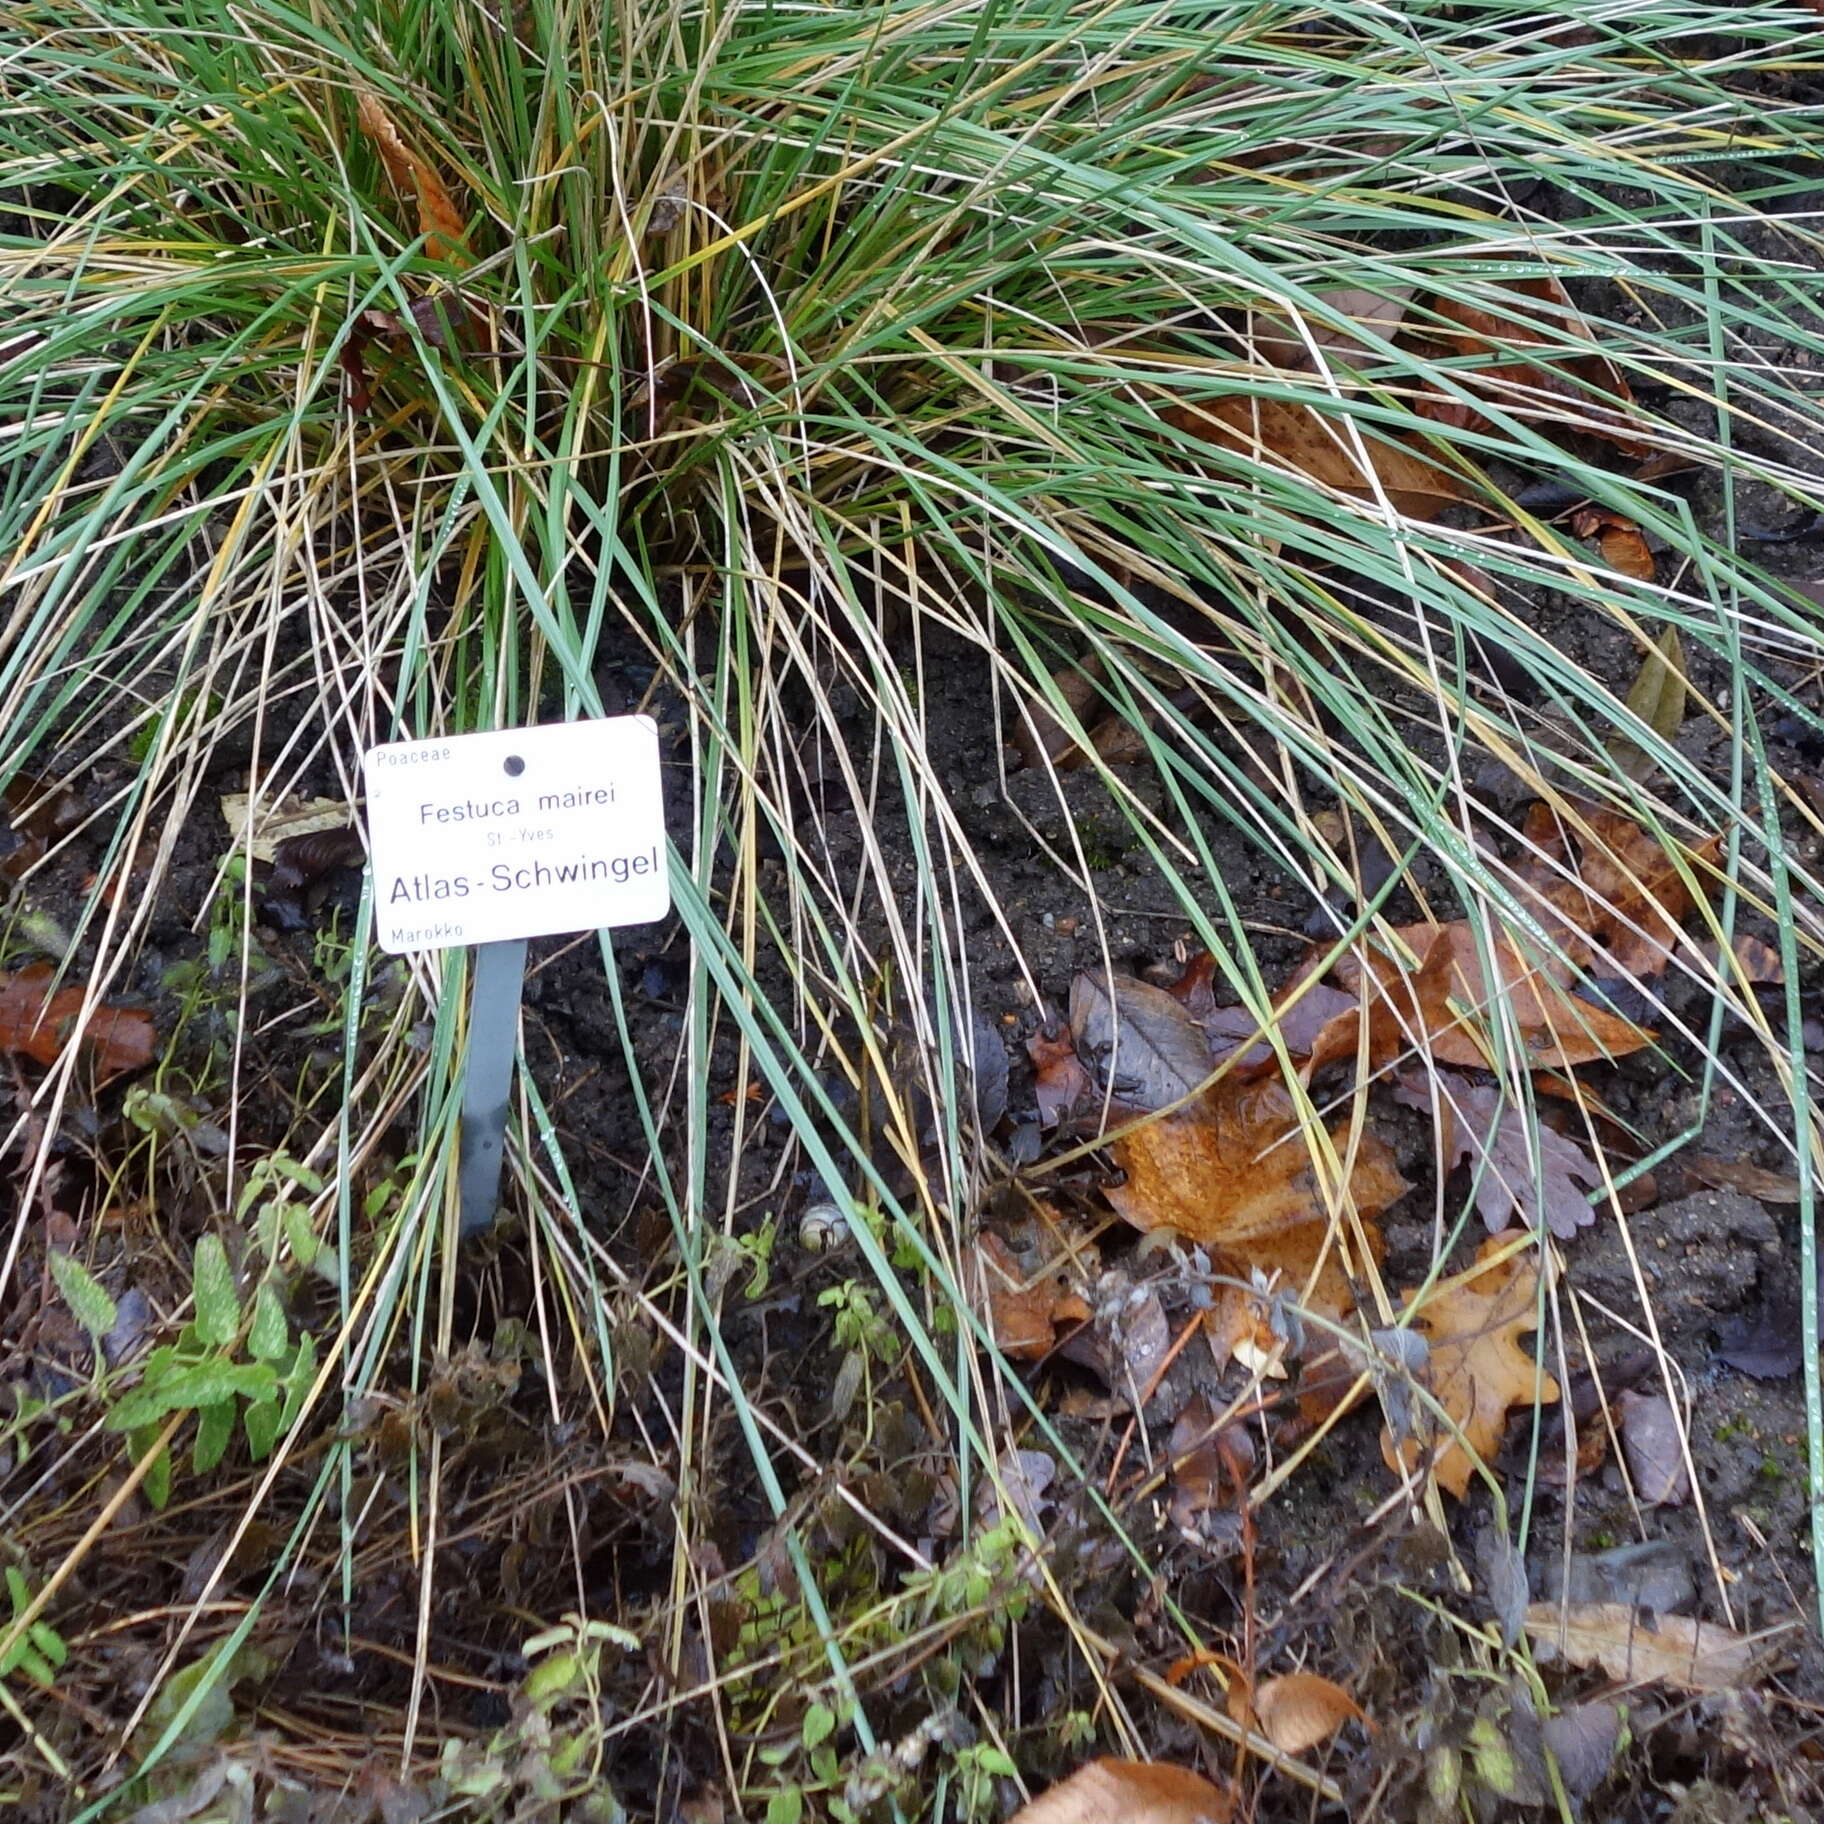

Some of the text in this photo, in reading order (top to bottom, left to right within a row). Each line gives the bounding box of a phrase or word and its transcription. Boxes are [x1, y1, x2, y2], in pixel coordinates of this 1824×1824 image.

[376, 747, 451, 767] Poaceae
[420, 781, 616, 825] Festuca mairei
[391, 922, 464, 944] Marokko
